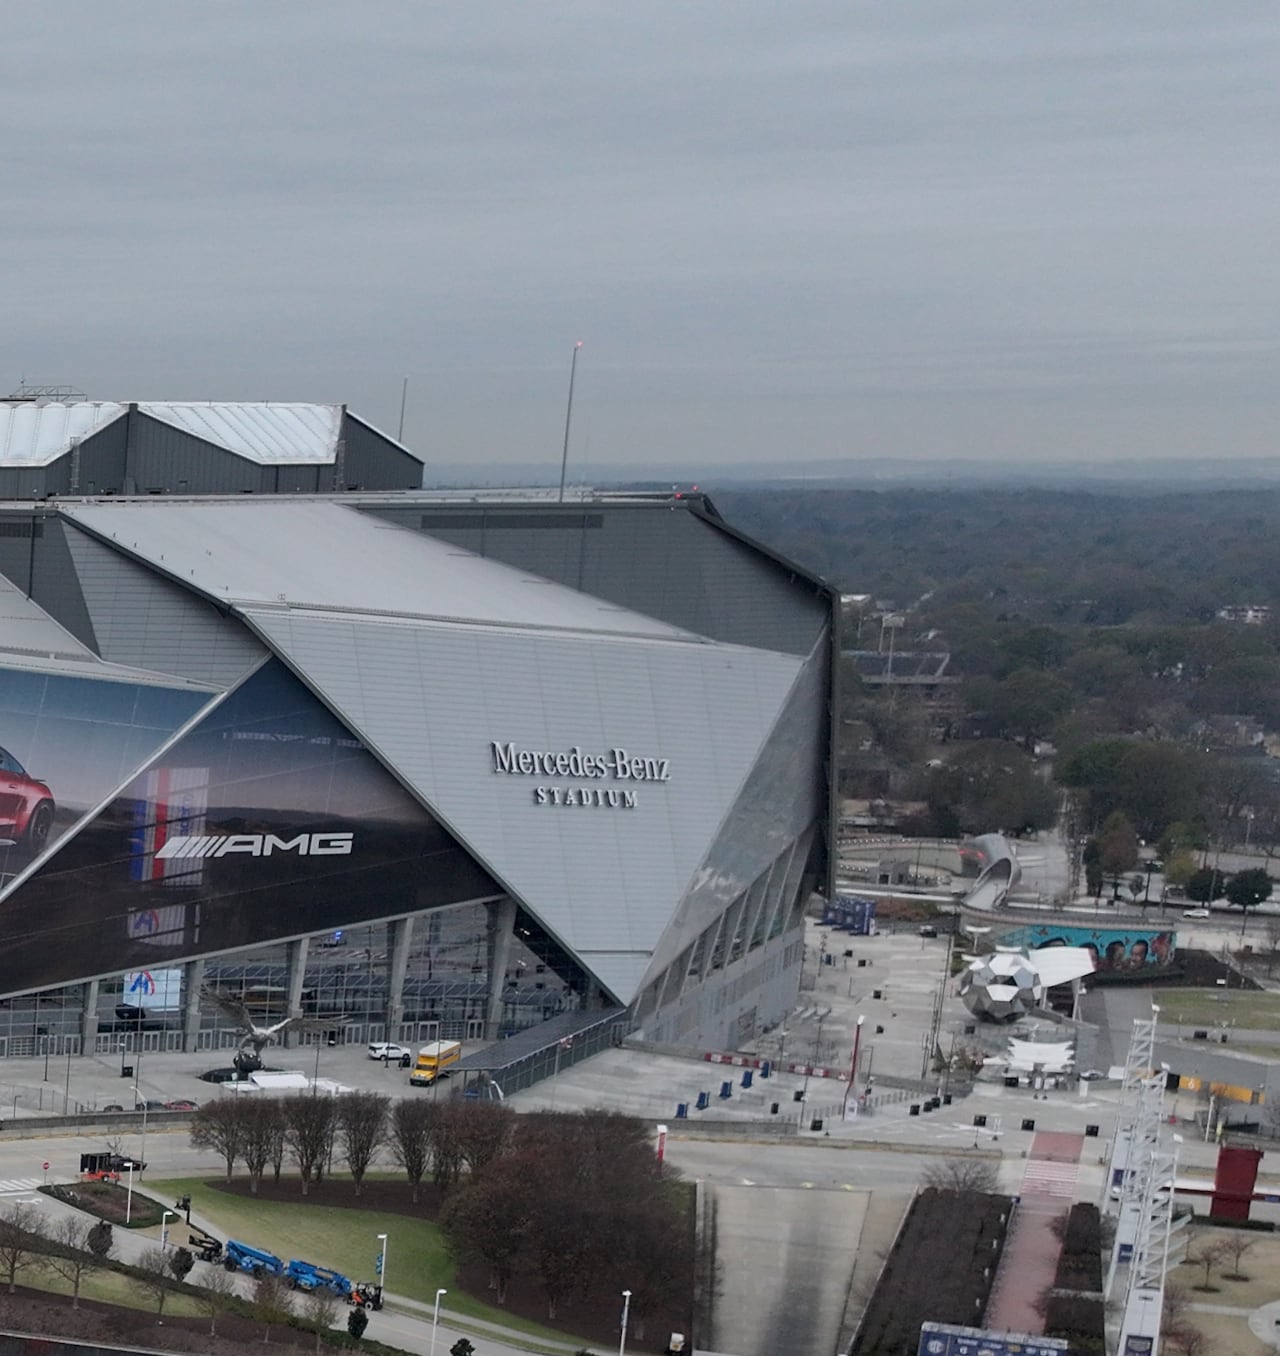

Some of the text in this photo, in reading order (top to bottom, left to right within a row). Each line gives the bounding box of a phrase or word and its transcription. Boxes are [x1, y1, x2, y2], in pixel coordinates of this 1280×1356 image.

[491, 740, 672, 781] Mercedes-Benz
[535, 786, 638, 808] STADIUM
[212, 832, 354, 858] AMG
